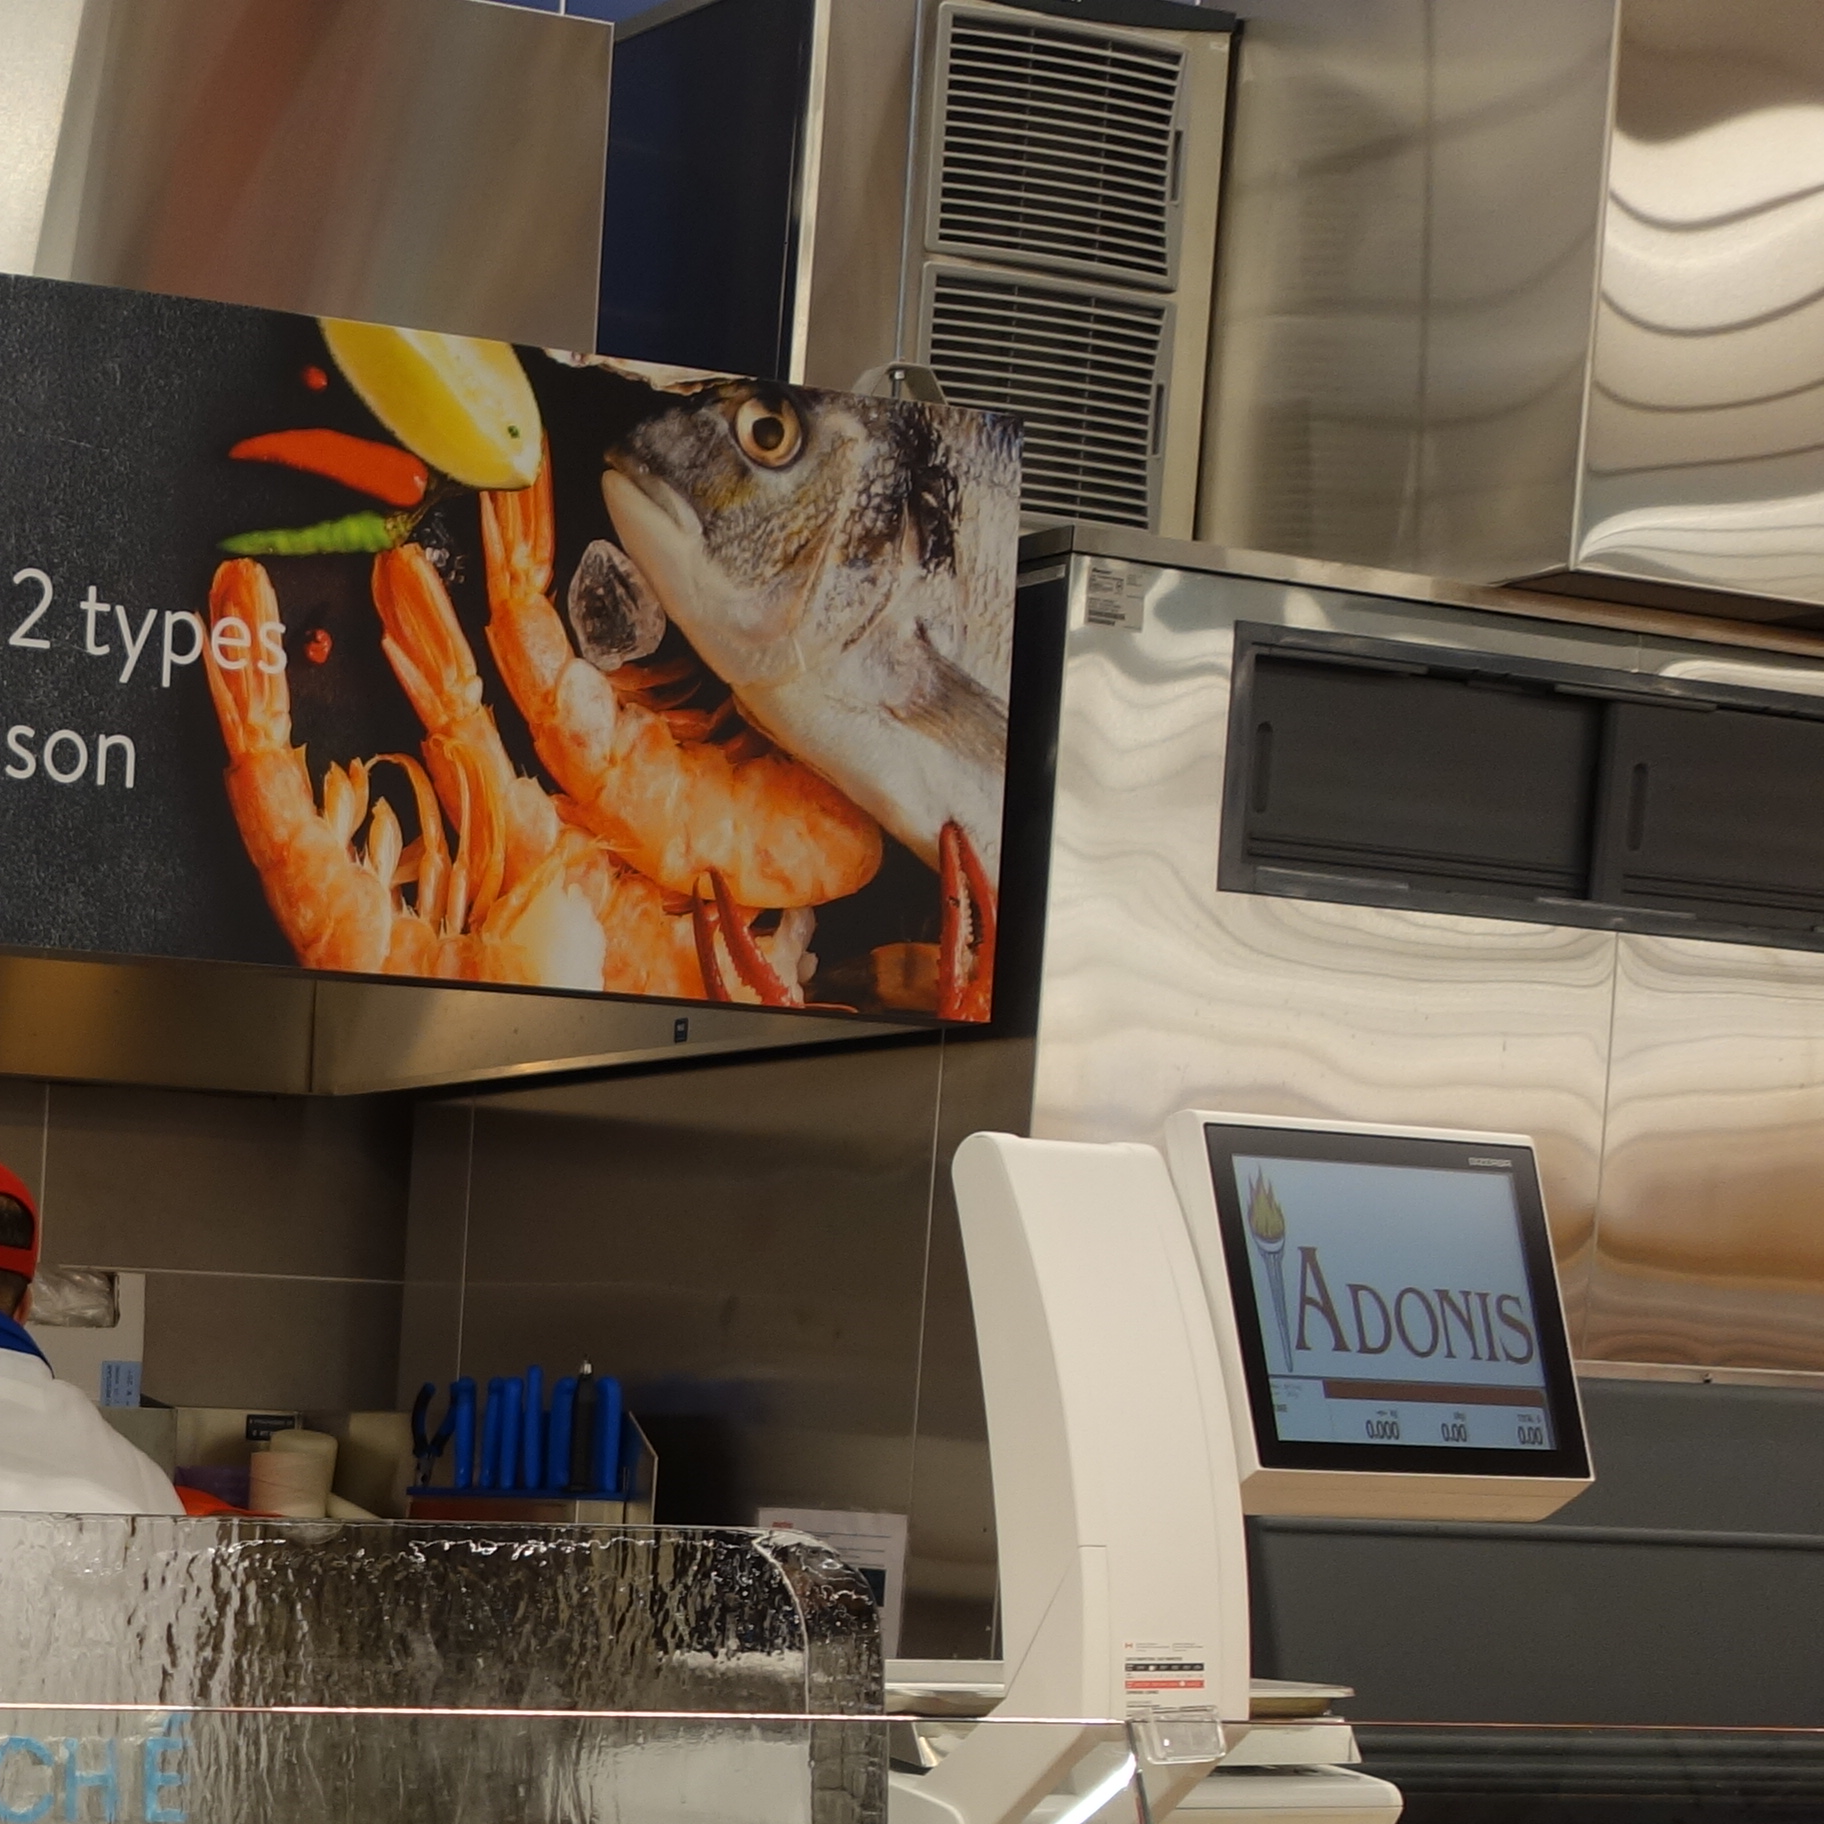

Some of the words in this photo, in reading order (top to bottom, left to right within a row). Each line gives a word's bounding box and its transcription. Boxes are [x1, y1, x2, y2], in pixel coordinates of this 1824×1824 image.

[9, 567, 51, 651] 2
[82, 594, 288, 689] types
[1296, 1246, 1536, 1366] ADONIS
